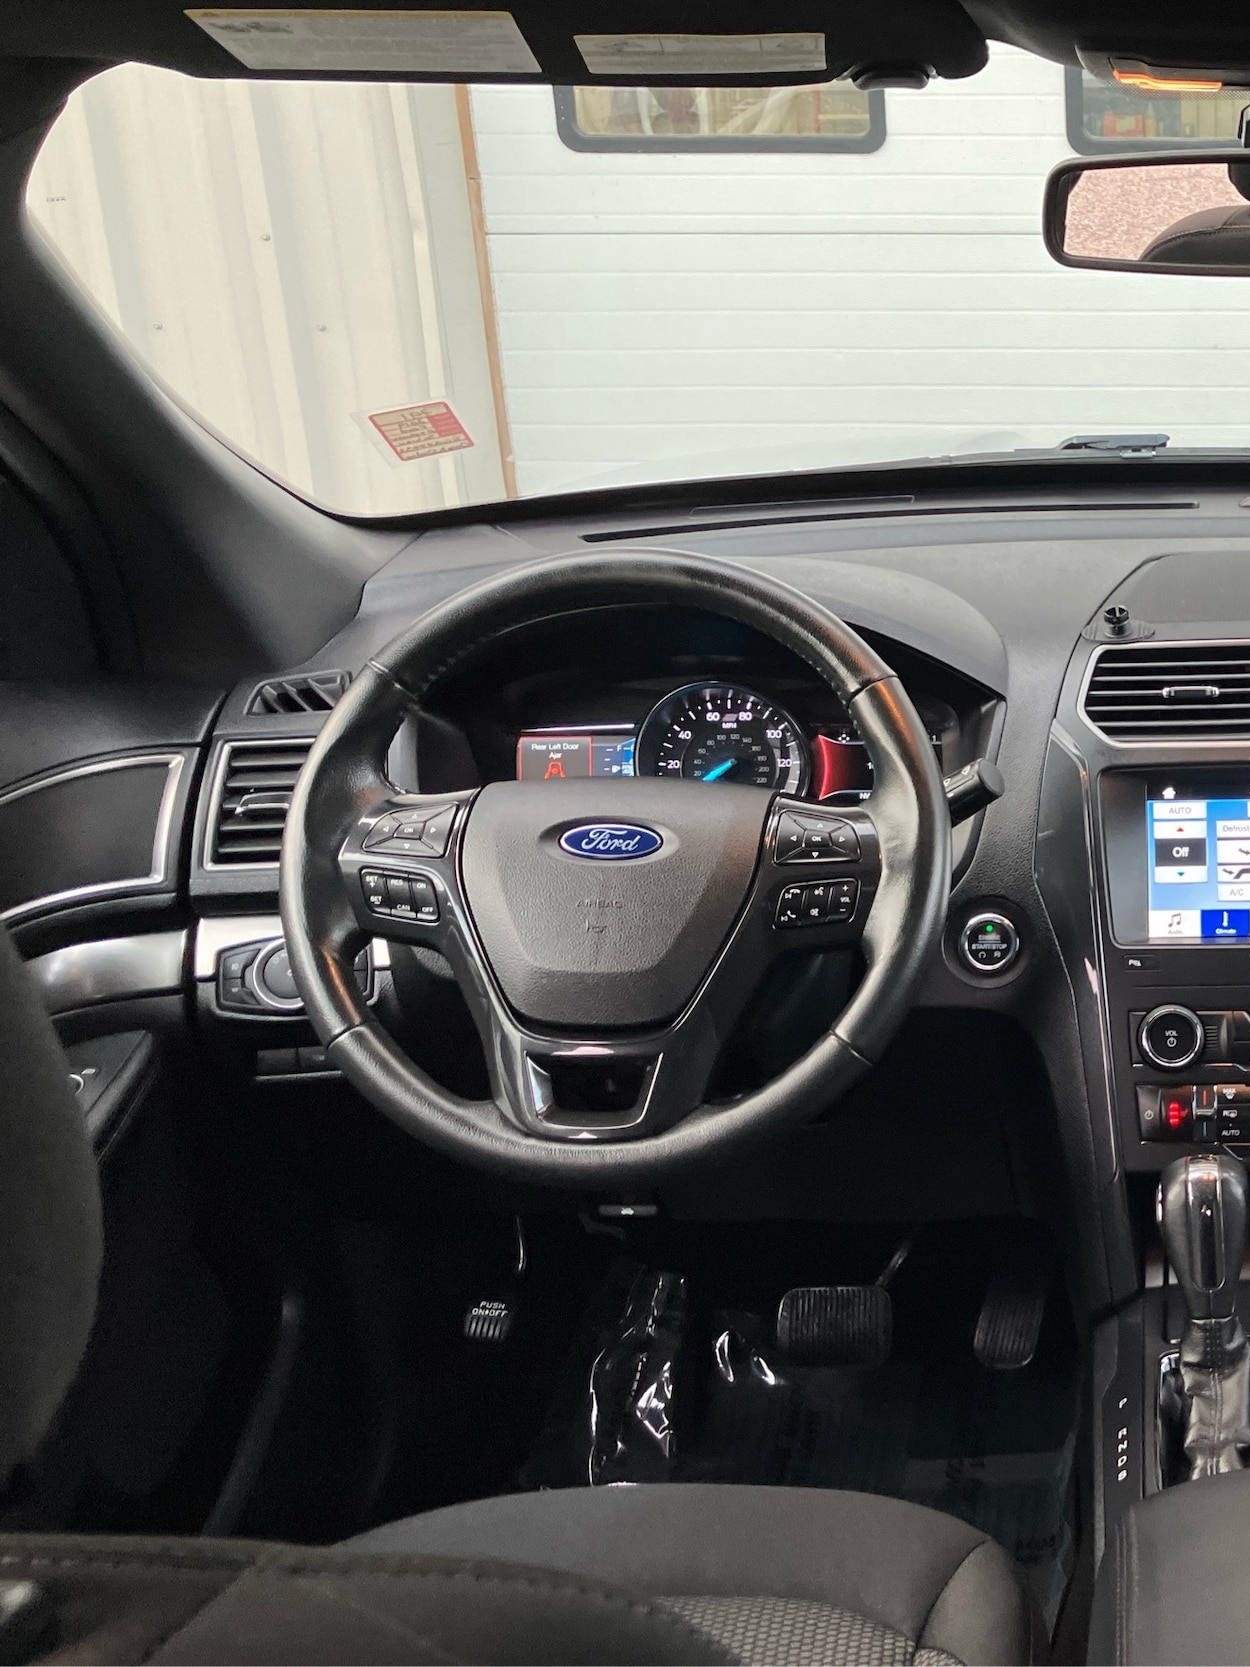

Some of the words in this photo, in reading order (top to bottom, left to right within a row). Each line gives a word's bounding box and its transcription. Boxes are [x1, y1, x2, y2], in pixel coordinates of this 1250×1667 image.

[706, 711, 720, 721] 60
[738, 711, 752, 721] 80
[678, 730, 692, 739] 40
[766, 729, 782, 738] 100
[548, 742, 561, 750] Left
[563, 742, 579, 750] Door
[549, 752, 562, 760] Ajar
[667, 760, 680, 769] 20
[777, 758, 792, 768] 120
[1169, 806, 1191, 814] AUTO
[581, 829, 641, 851] Ford
[1172, 846, 1189, 857] Off
[480, 1301, 505, 1309] PUSH
